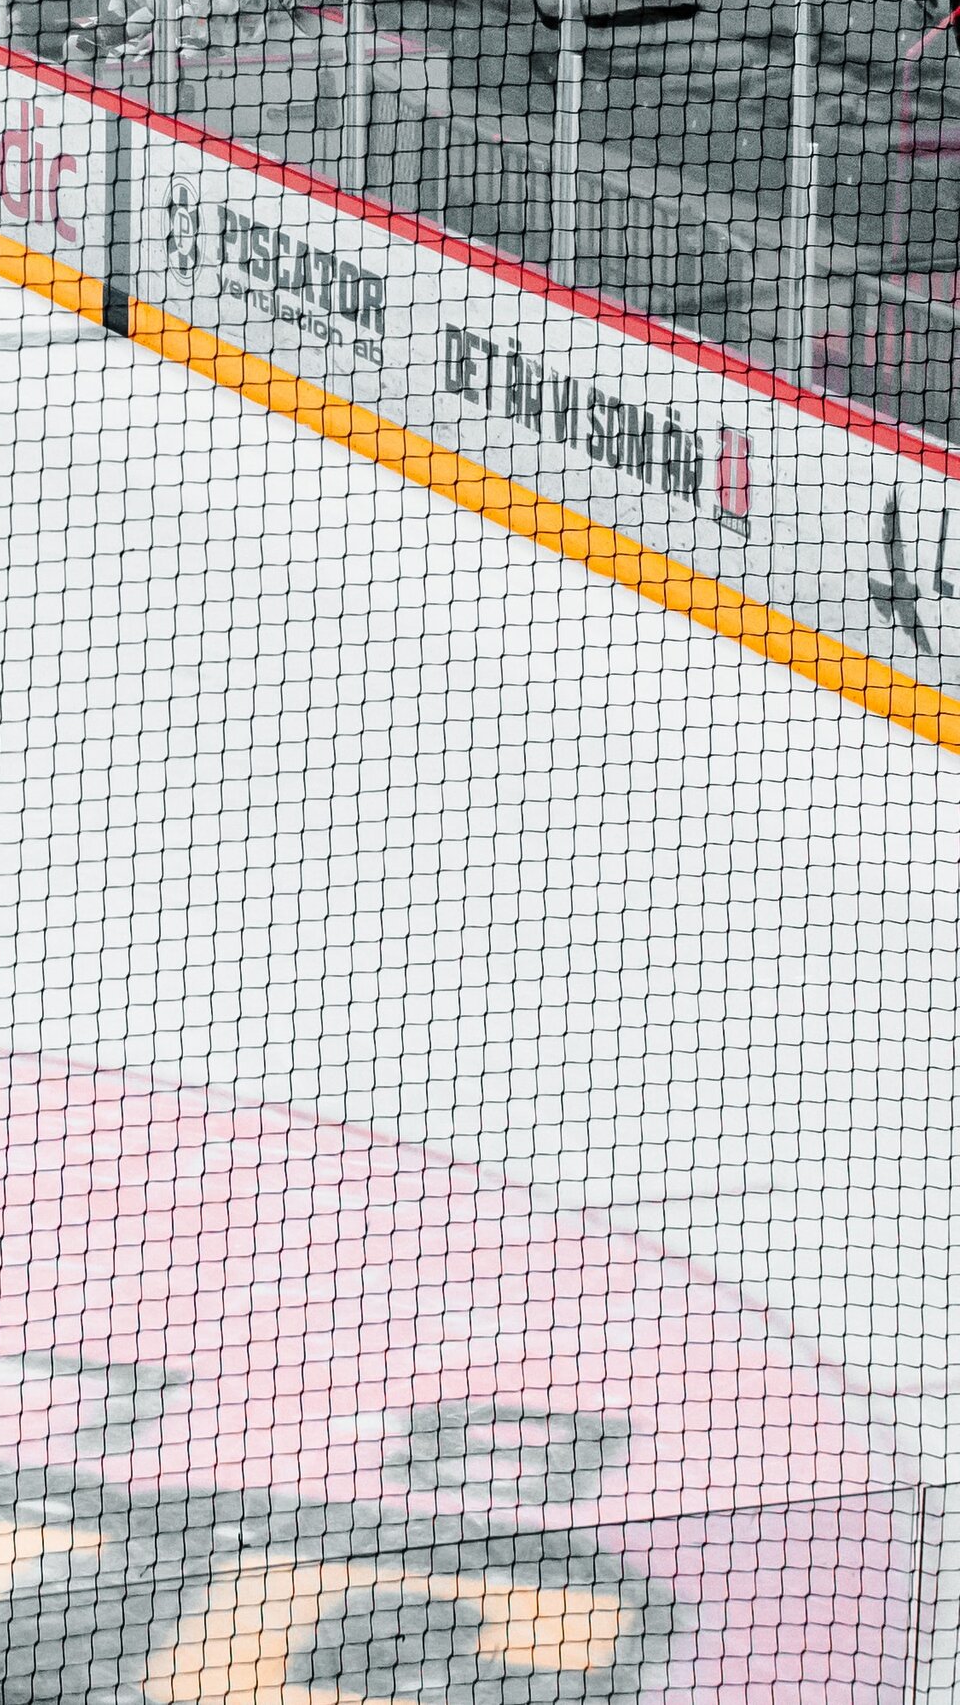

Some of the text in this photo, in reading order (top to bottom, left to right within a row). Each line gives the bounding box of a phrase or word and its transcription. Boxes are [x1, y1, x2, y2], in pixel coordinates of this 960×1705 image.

[216, 204, 384, 335] PISCATOR
[216, 273, 384, 366] ventilation ab
[445, 322, 498, 411] DET
[551, 366, 579, 450] VI
[586, 386, 654, 485] SOM
